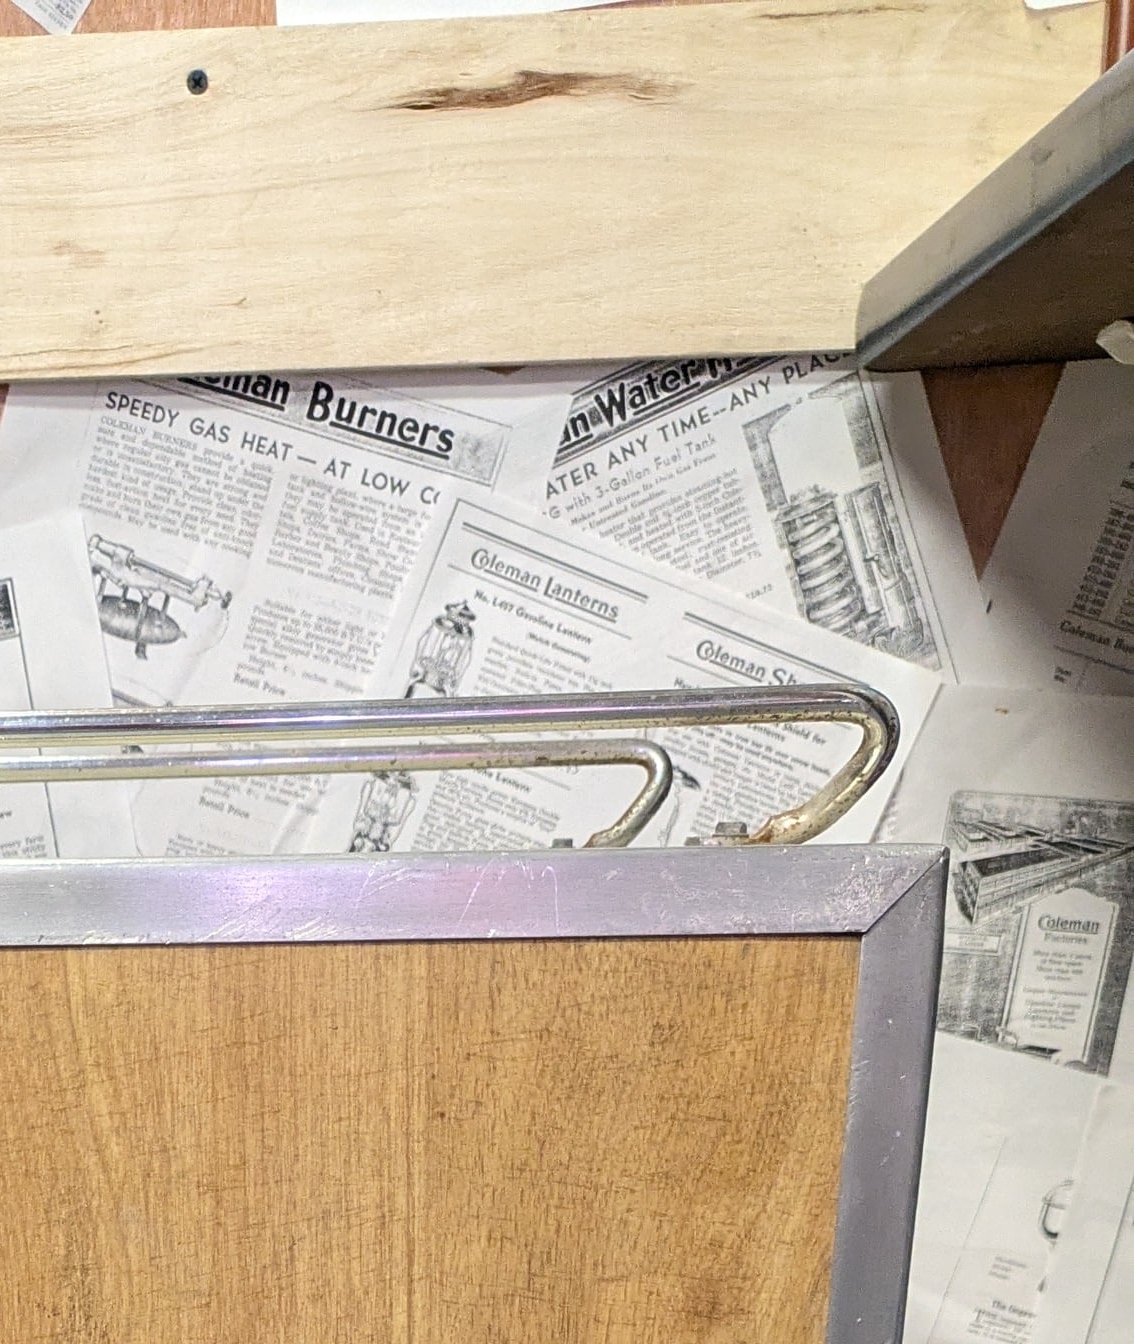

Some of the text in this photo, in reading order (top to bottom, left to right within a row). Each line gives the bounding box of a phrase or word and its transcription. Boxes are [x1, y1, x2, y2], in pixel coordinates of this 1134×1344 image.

[307, 381, 454, 455] Burners
[594, 360, 696, 428] Water
[100, 415, 197, 451] COLEMAN BURNERS
[105, 391, 180, 428] SPEEDY
[189, 417, 232, 444] GAS
[240, 432, 294, 462] HEAT
[323, 457, 352, 480] AT
[360, 468, 410, 497] LOW
[546, 462, 598, 500] ATER
[608, 434, 649, 470] ANY
[565, 491, 592, 513] with
[595, 467, 651, 499] 3-Gallon
[654, 446, 682, 471] Fuel
[686, 432, 717, 456] Tank
[471, 548, 619, 620] Coleman Lanterns
[696, 639, 766, 680] Coleman
[1038, 915, 1100, 932] Coleman
